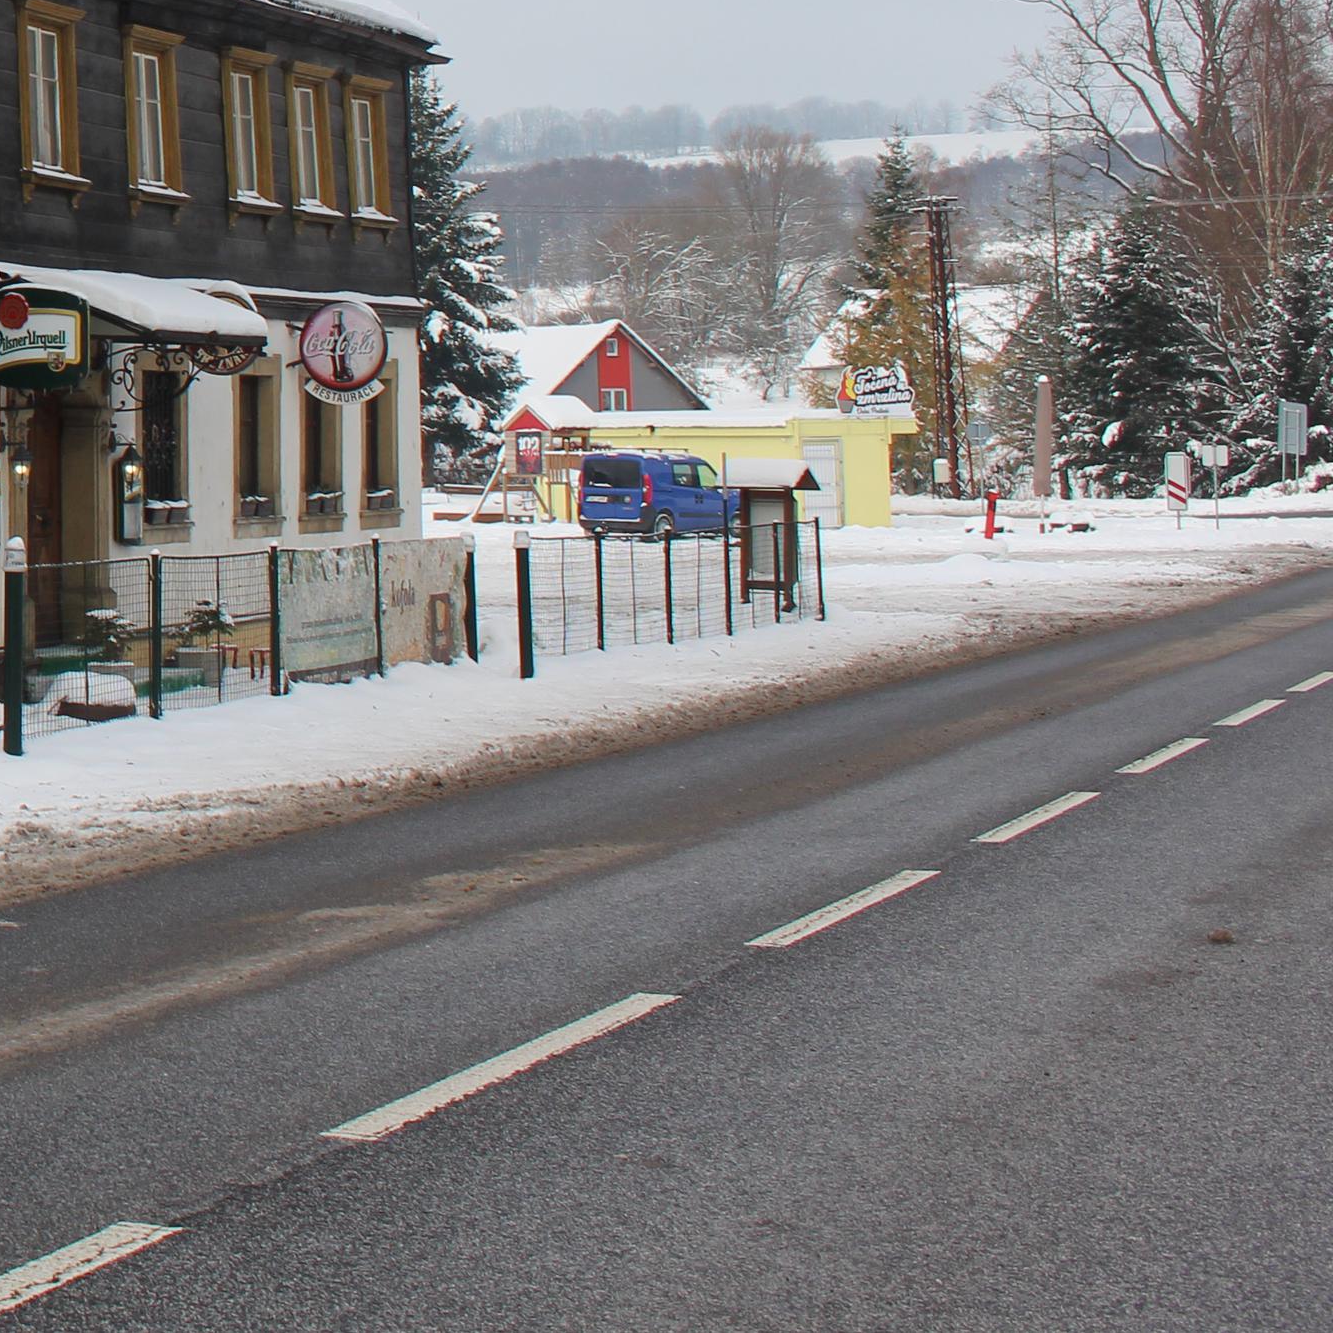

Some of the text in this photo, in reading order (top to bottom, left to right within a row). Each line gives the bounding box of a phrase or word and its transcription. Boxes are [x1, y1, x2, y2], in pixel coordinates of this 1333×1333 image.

[27, 329, 67, 351] Urquell
[312, 384, 377, 403] RESTAURACE
[856, 388, 911, 405] zmrzlina
